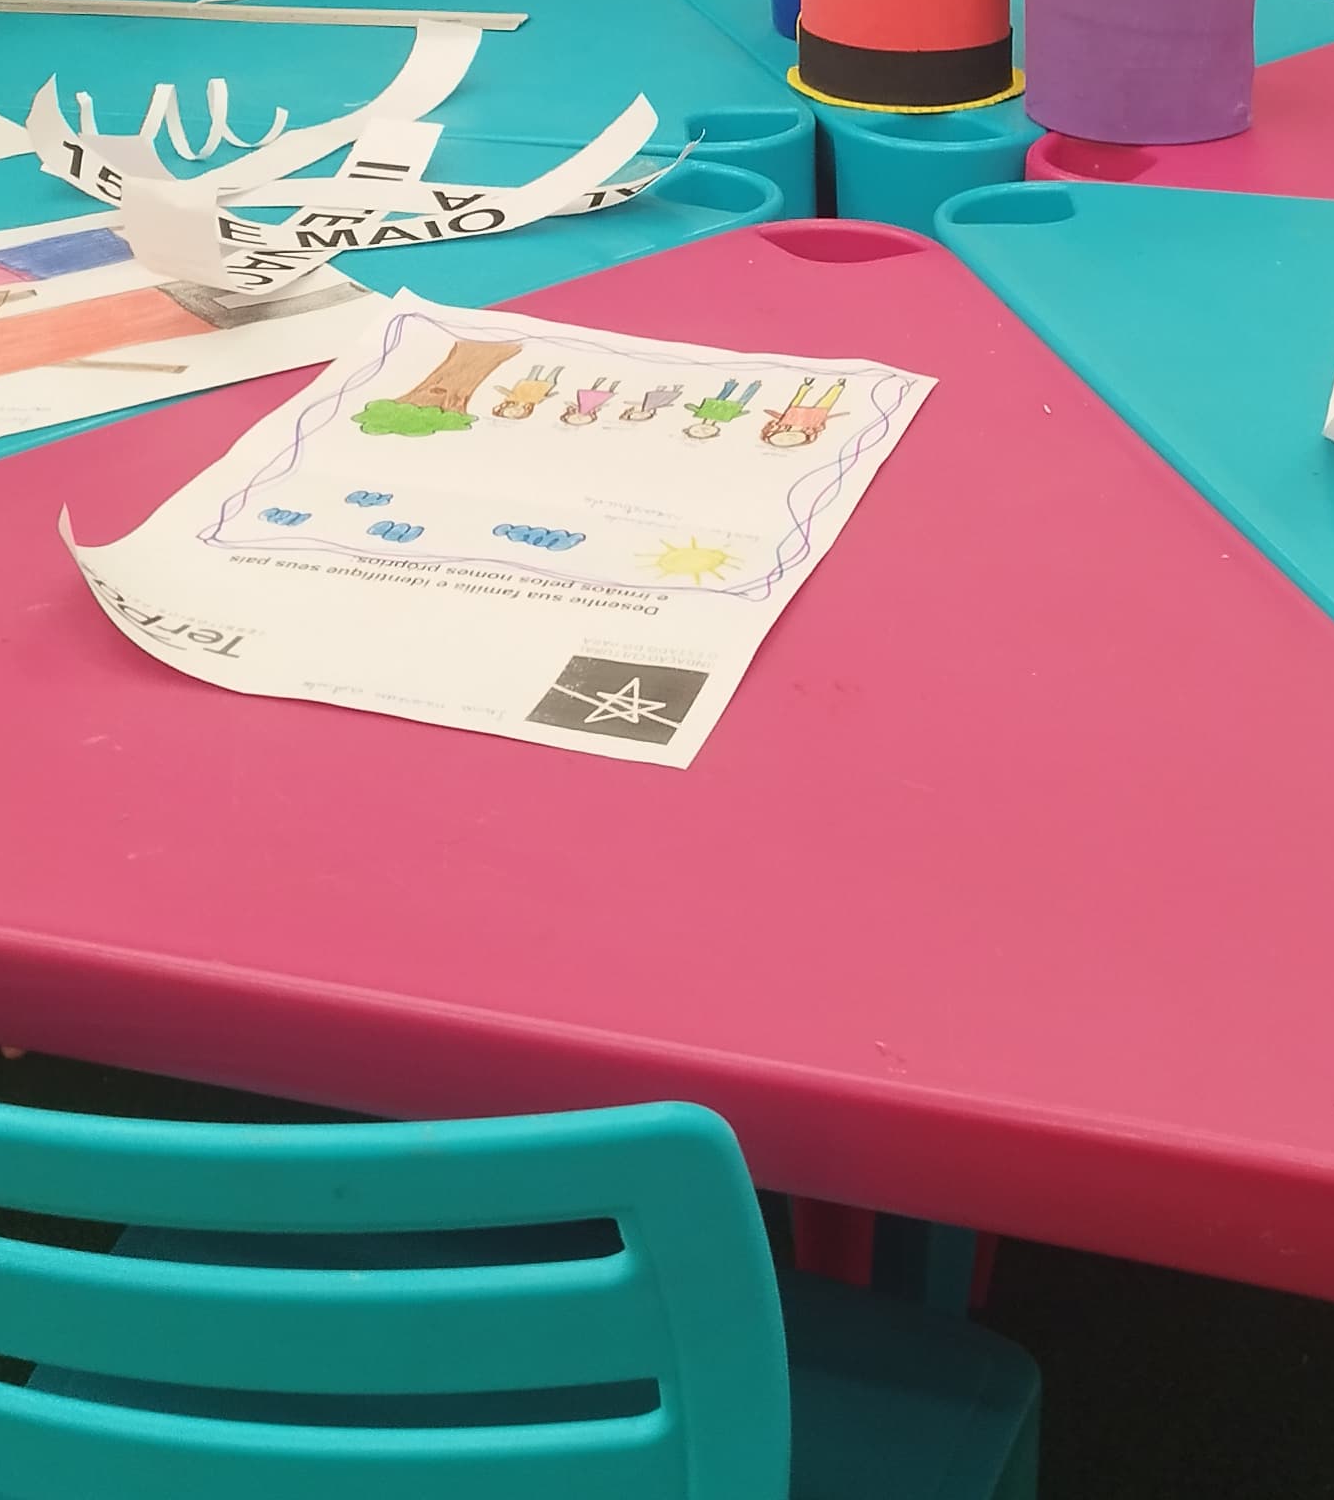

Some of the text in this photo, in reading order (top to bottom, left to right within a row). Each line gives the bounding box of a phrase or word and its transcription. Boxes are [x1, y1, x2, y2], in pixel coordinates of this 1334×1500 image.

[62, 140, 122, 201] 15
[295, 208, 506, 249] MAIO
[228, 554, 272, 566] pais
[274, 559, 320, 572] seus
[326, 566, 431, 589] identifique
[445, 566, 513, 583] nomes
[519, 575, 576, 591] pelos
[527, 590, 564, 602] sua
[580, 583, 651, 601] irmãos
[569, 597, 660, 617] Desenhe
